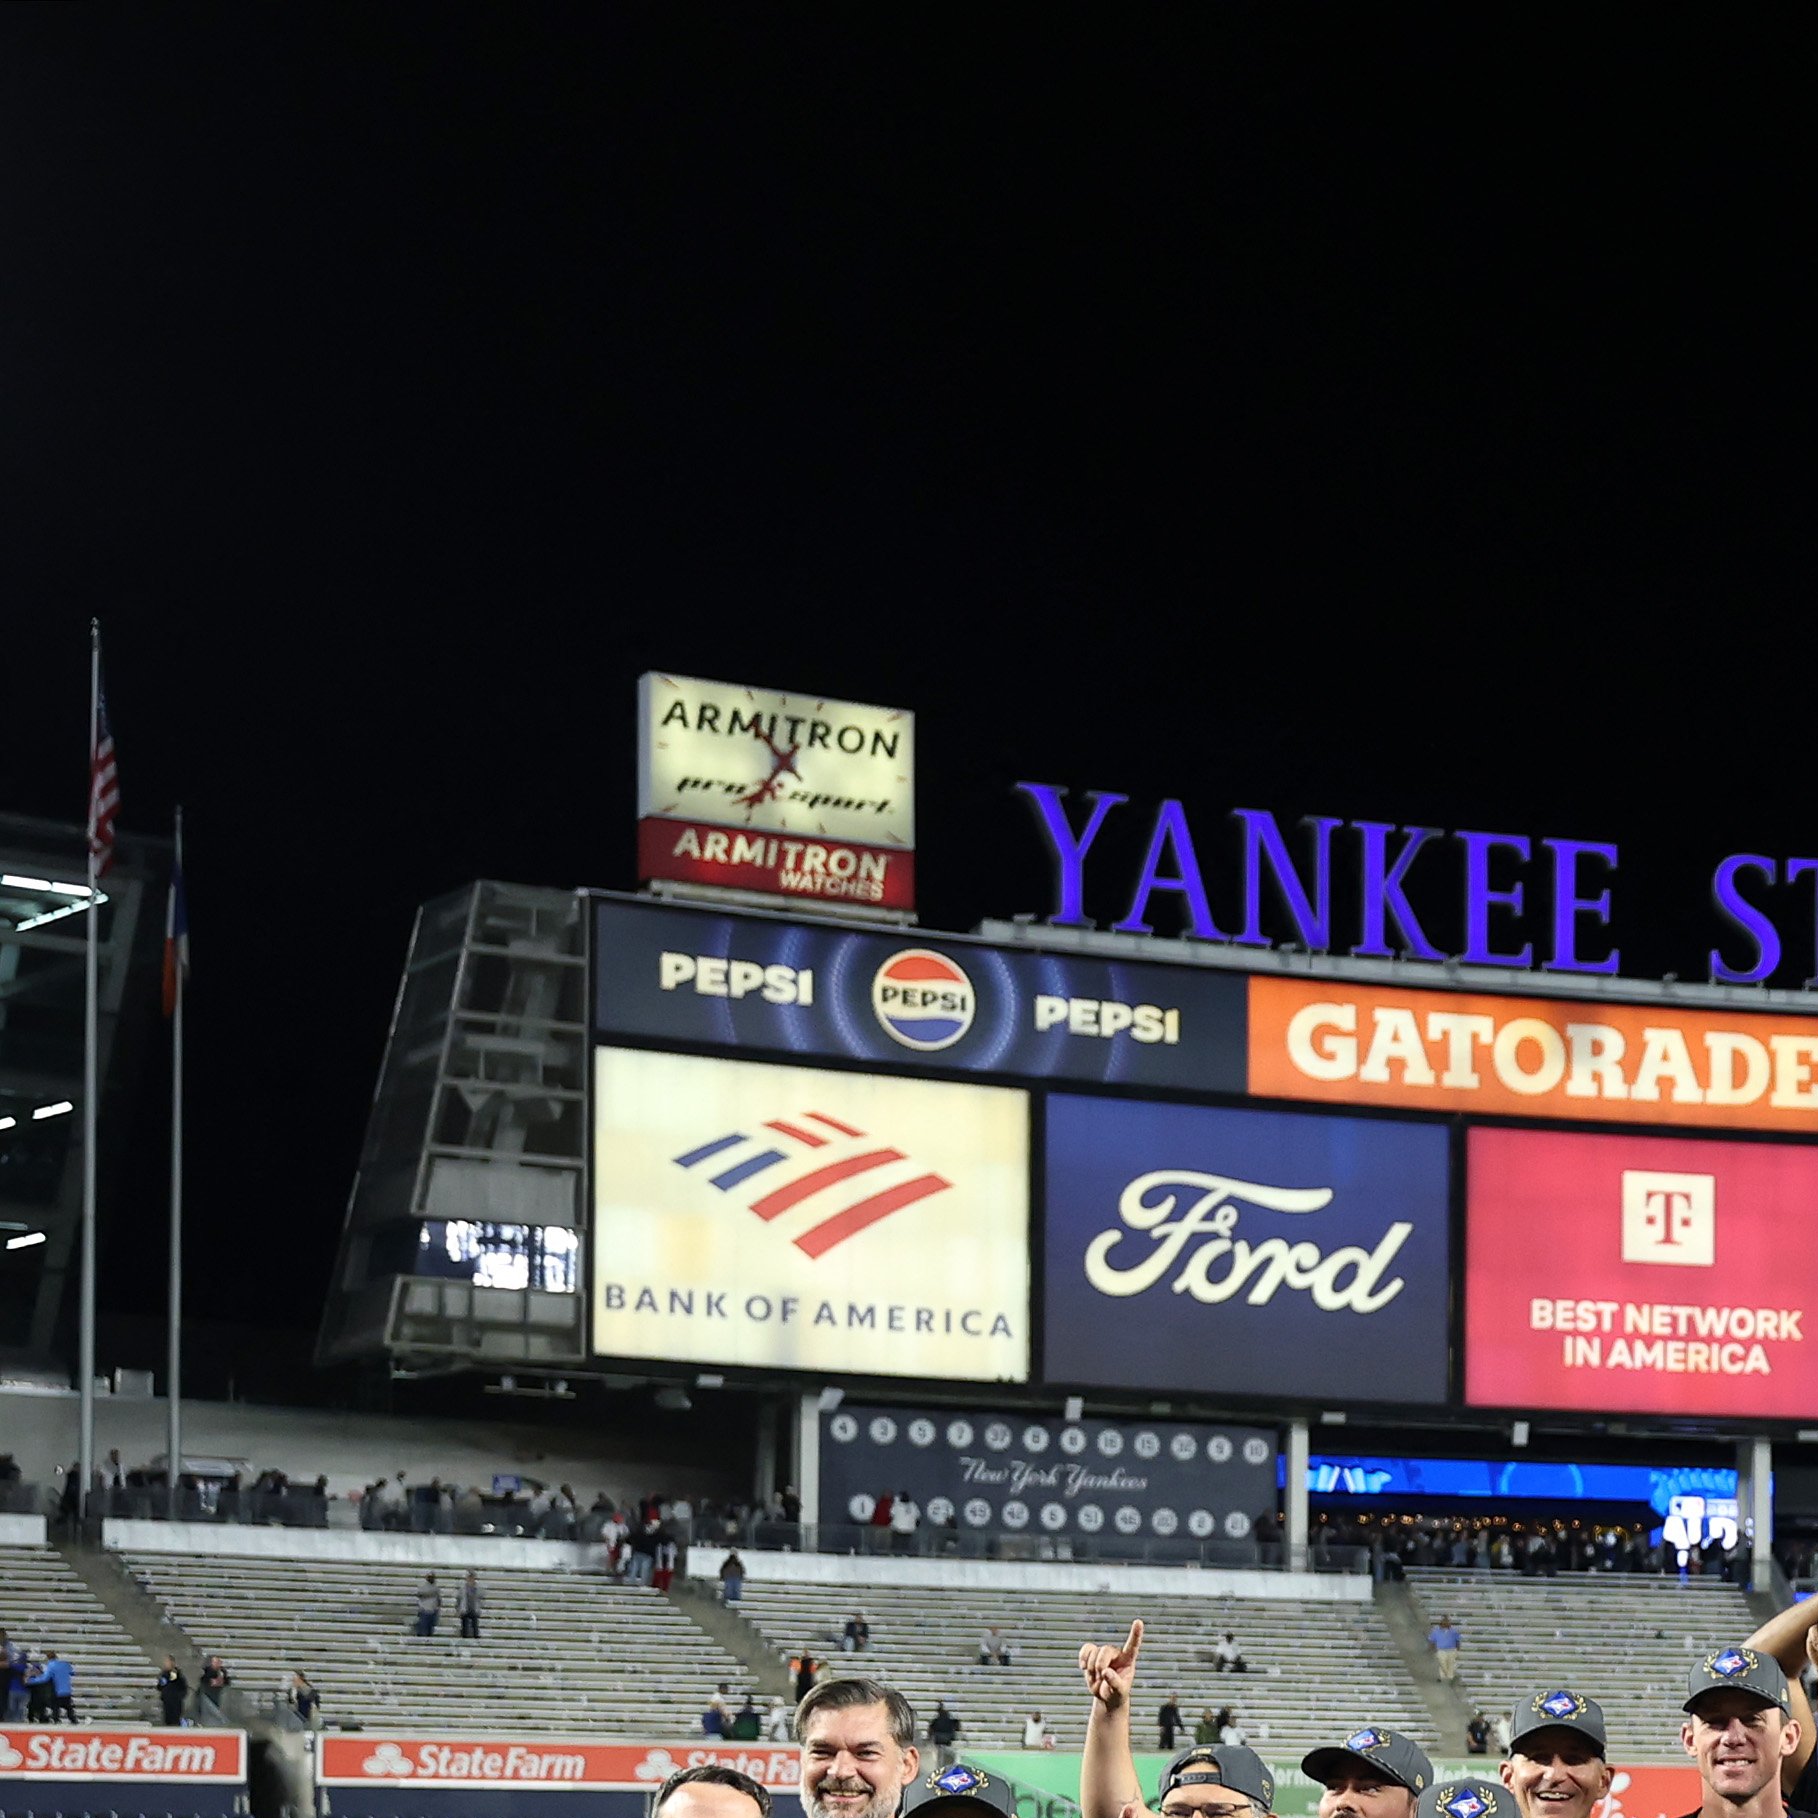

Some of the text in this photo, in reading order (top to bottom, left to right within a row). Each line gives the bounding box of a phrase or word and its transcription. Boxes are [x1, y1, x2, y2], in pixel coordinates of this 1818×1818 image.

[661, 699, 899, 759] ARMITRON
[673, 829, 887, 881] ARMITRON
[1015, 781, 1620, 974] YANKEE
[779, 867, 885, 900] WATCHES
[660, 952, 813, 1006] PEPSI
[881, 985, 969, 1014] PEPSI
[1036, 995, 1180, 1044] PEPSI
[1084, 1169, 1413, 1314] Ford
[605, 1284, 1014, 1339] BANK OF AMERICA
[1531, 1297, 1803, 1342] BEST NETWORK
[1564, 1335, 1771, 1375] IN AMERICA
[960, 1457, 1148, 1497] New York Yankees
